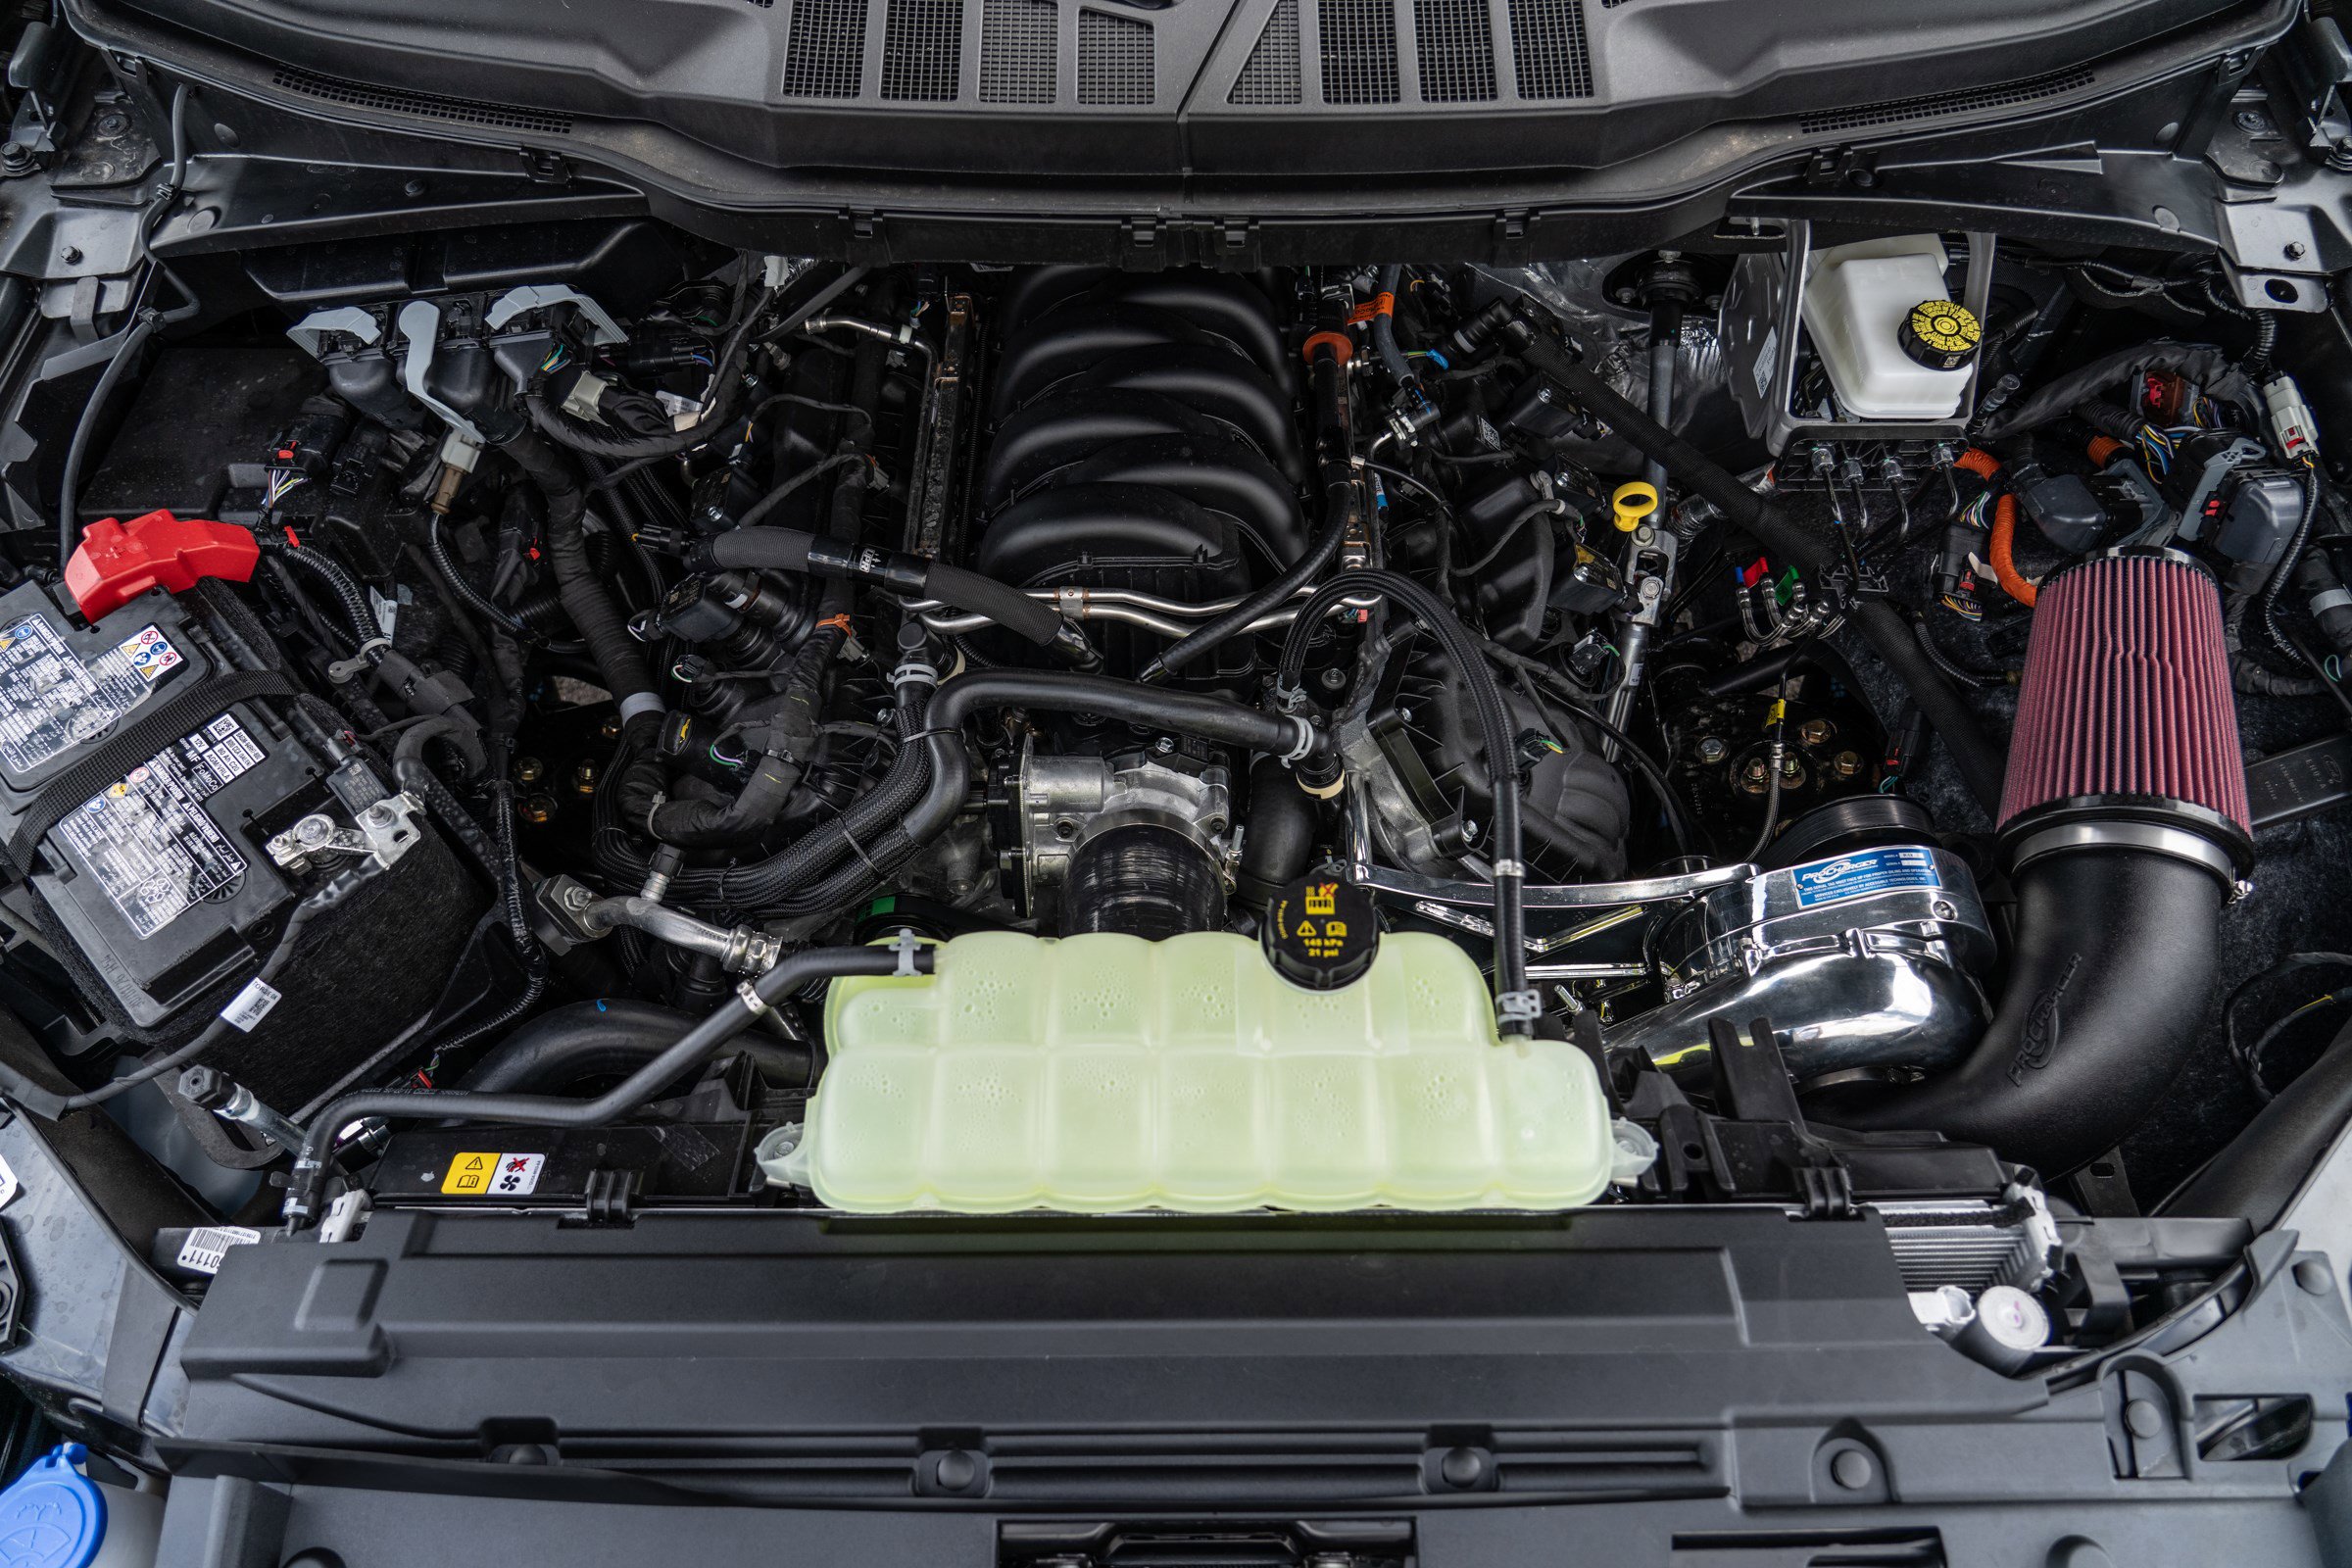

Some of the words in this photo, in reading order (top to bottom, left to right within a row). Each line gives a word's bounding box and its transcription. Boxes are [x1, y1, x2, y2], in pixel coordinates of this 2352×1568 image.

[184, 749, 201, 764] MF
[194, 762, 220, 791] FoMoCo
[193, 737, 205, 748] 12V
[206, 753, 230, 779] AGM/VRLA
[228, 760, 239, 771] C20
[186, 805, 220, 844] PELIGRO/VENENO
